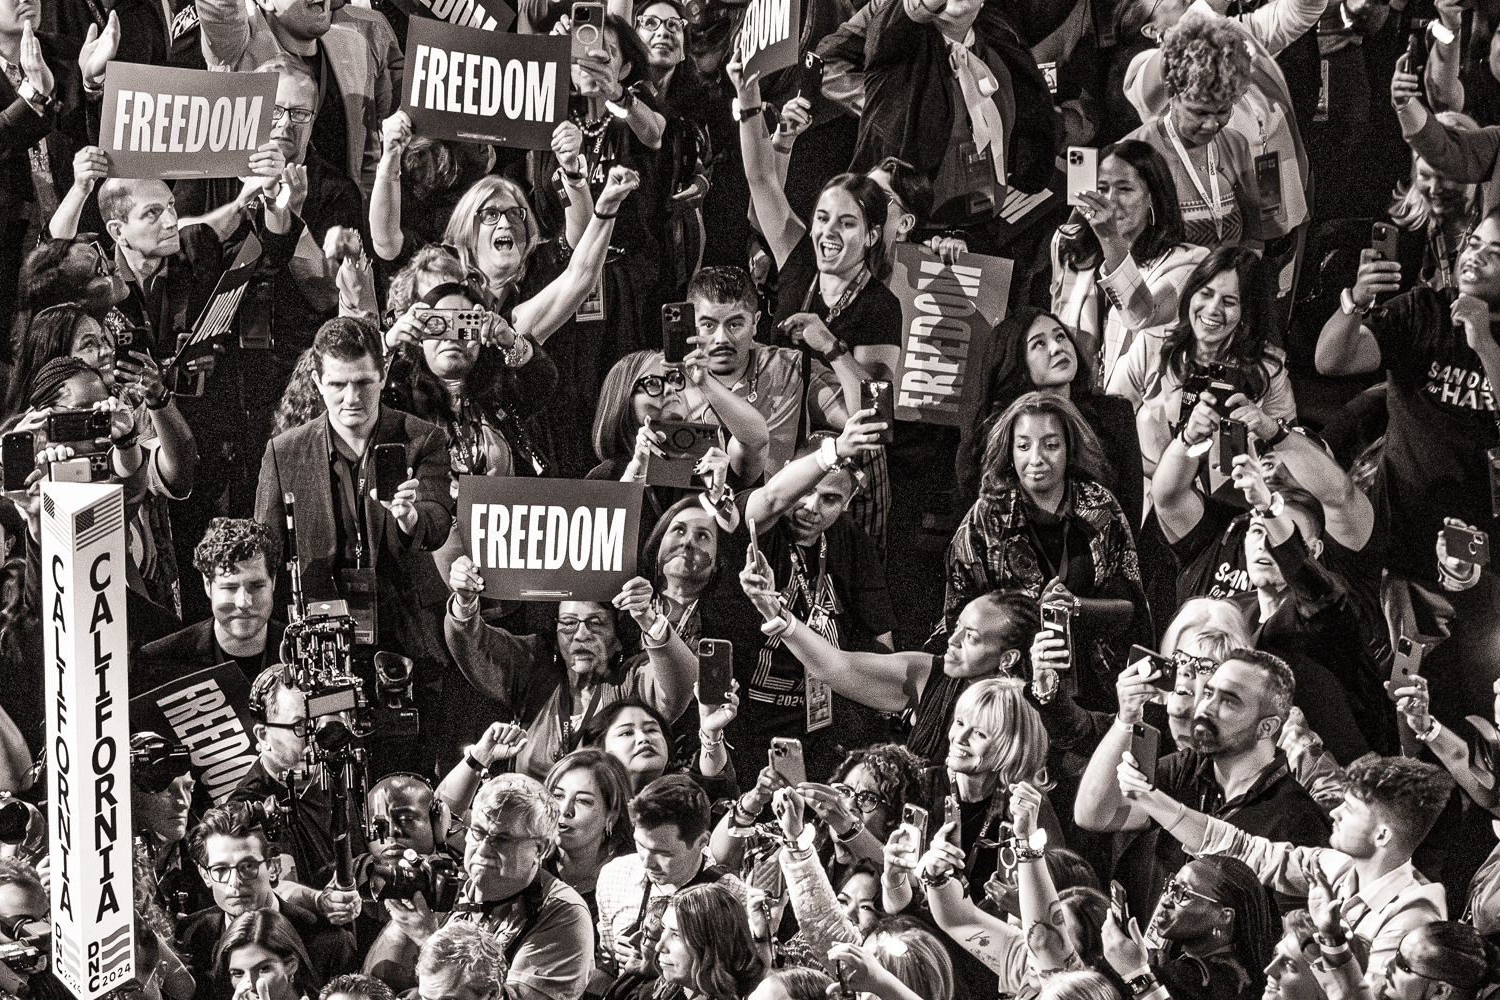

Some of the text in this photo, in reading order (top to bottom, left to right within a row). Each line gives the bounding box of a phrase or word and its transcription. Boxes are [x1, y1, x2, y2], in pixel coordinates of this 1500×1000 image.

[409, 44, 557, 123] FREEDOM
[112, 89, 264, 153] FREEDOM
[471, 503, 626, 572] FREEDOM
[52, 554, 74, 923] CALIFORNIA
[89, 552, 120, 924] CALIFORNIA
[979, 821, 990, 838] DNC
[64, 970, 82, 995] 2024
[88, 941, 100, 993] DNC
[102, 962, 131, 988] 2024
